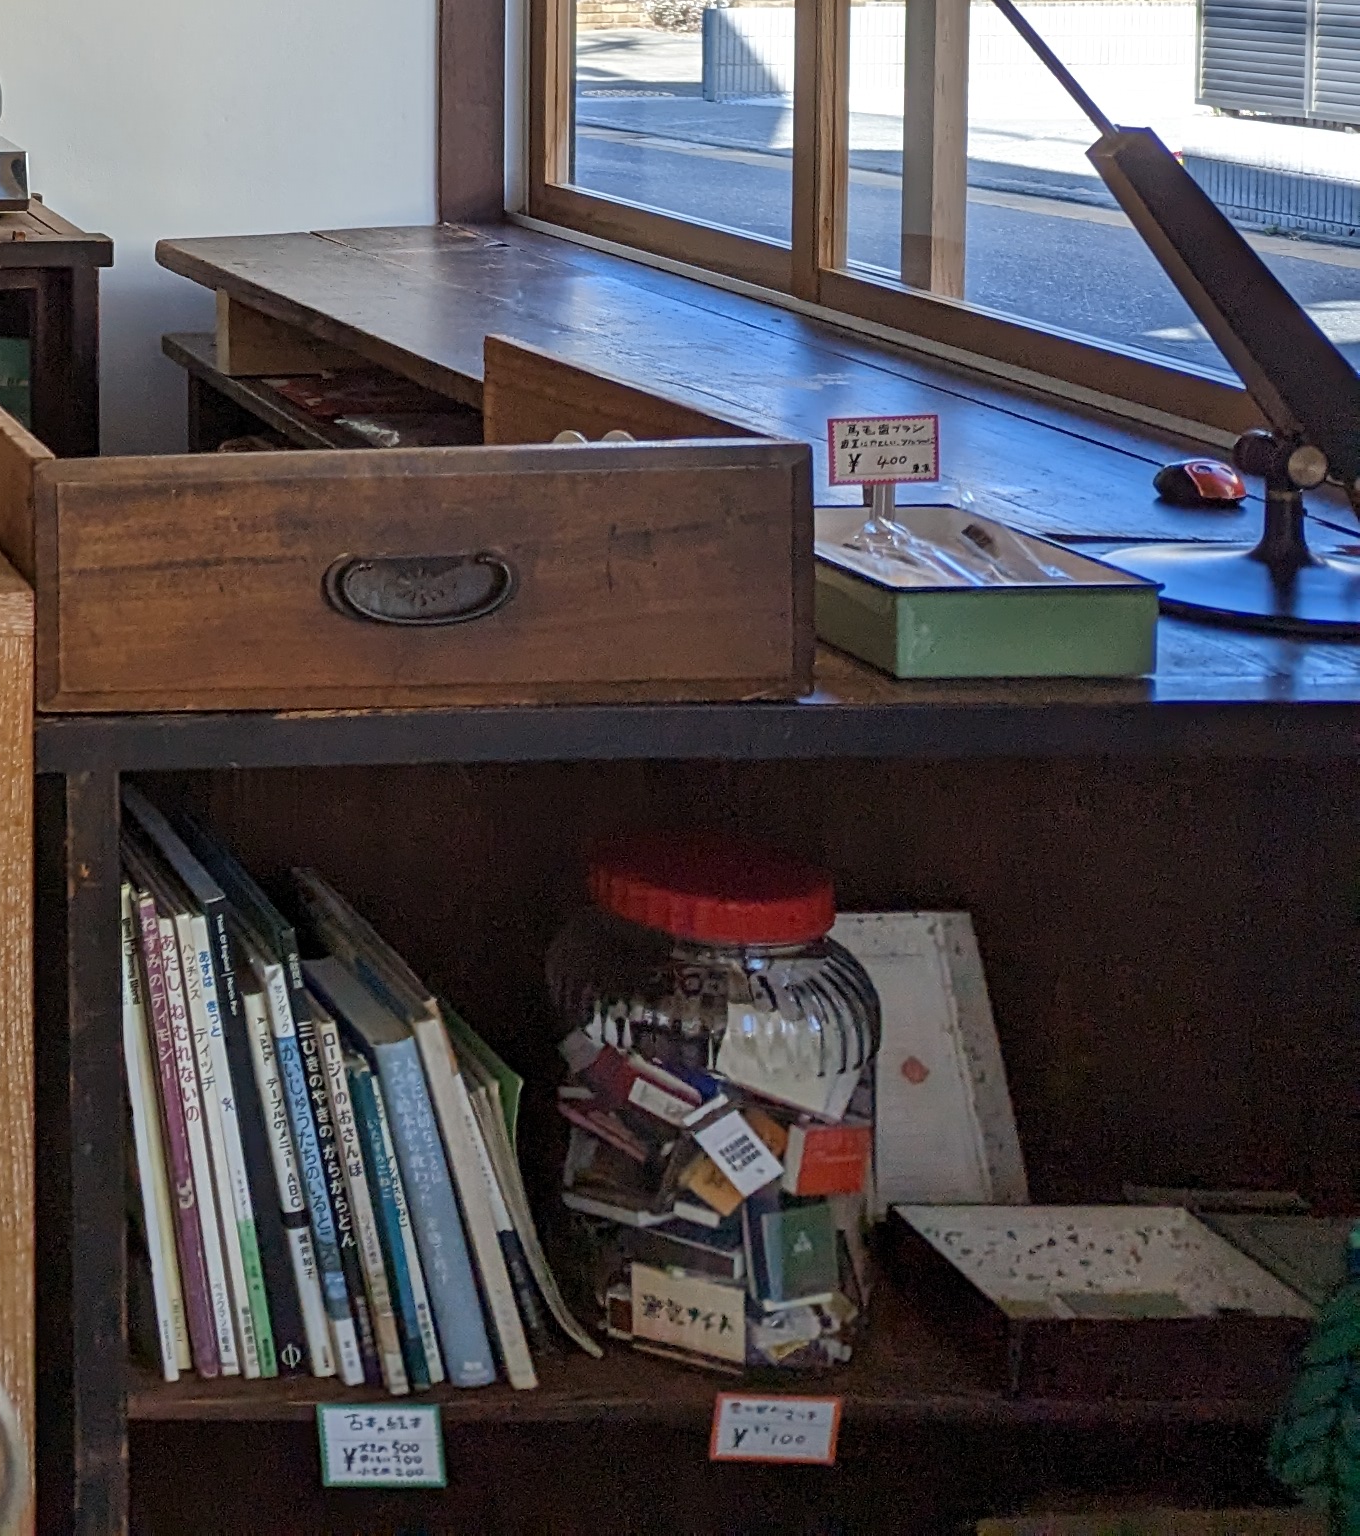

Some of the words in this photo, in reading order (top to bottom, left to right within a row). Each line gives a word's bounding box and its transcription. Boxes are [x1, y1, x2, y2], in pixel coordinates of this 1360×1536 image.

[877, 455, 907, 470] 400
[160, 935, 201, 1122] あたし、ねむれないの
[193, 1027, 217, 1091] ティッチ
[322, 1031, 364, 1178] ロージーのおさんぽ
[285, 1175, 304, 1209] ABC
[392, 1440, 420, 1454] 500
[771, 1434, 807, 1445] 100
